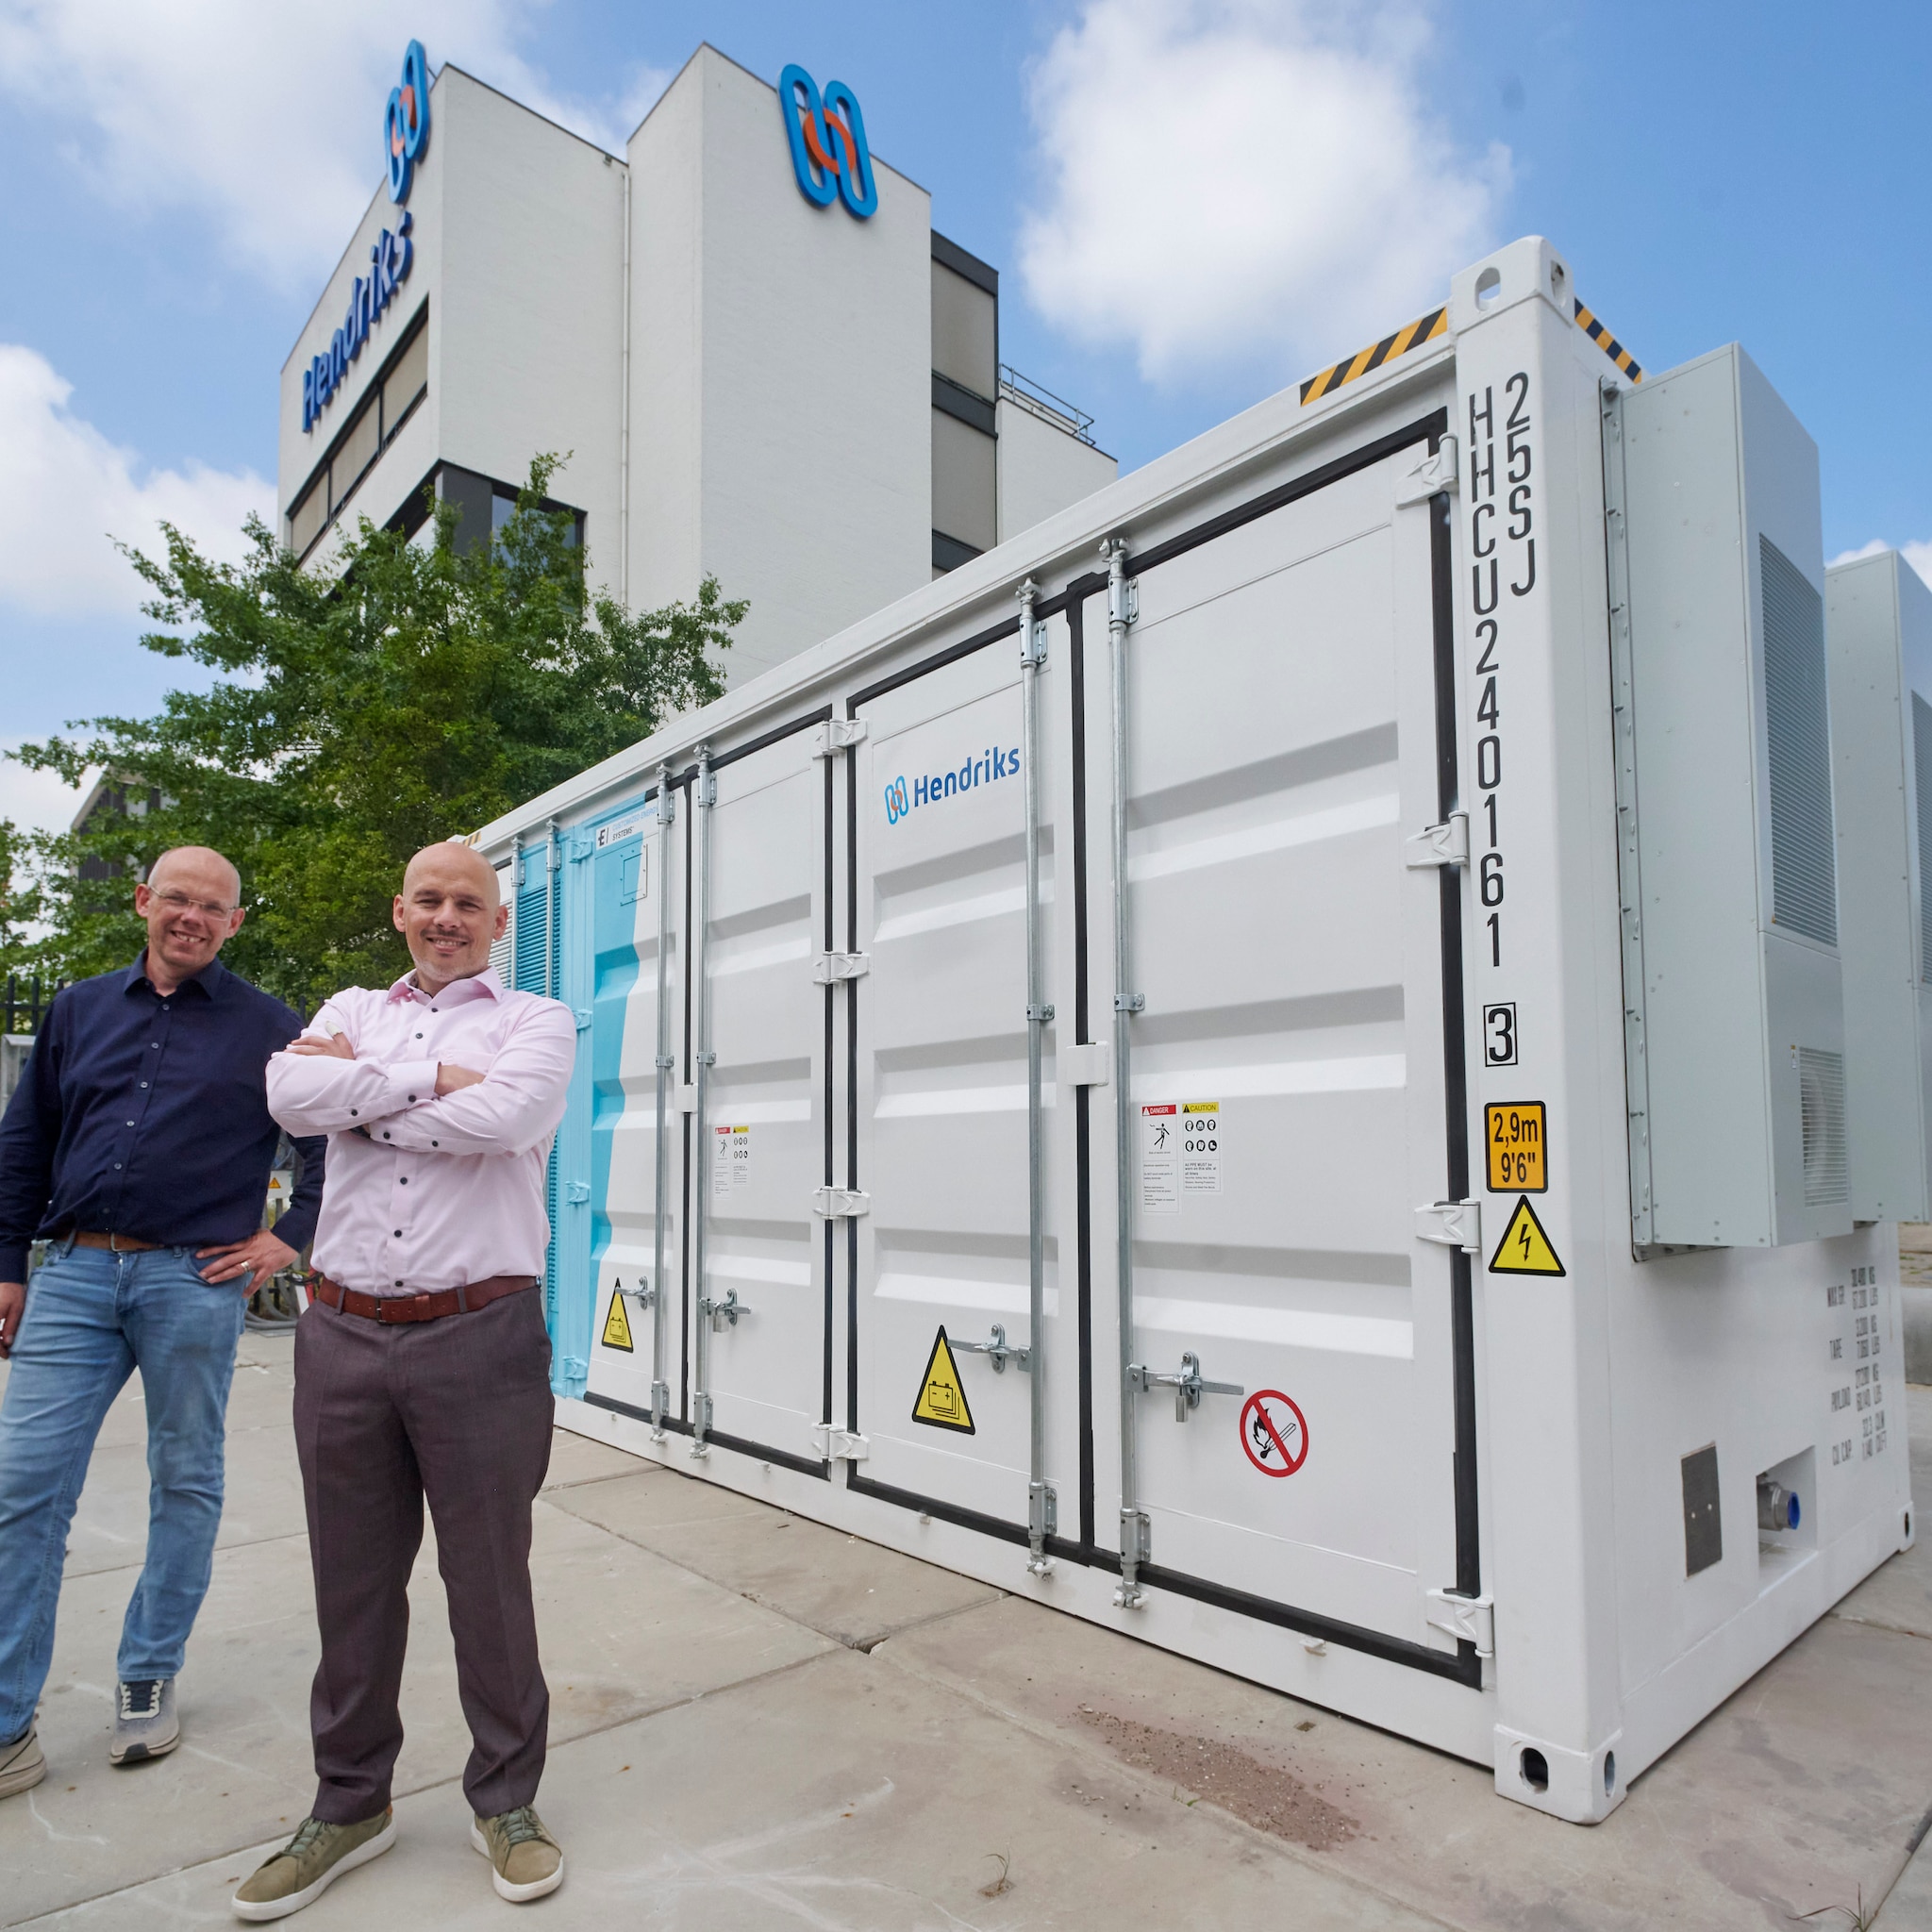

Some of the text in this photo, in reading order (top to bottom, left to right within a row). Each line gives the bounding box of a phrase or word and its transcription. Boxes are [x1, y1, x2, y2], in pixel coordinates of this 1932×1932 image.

[302, 210, 412, 433] Hendriks
[1505, 372, 1536, 596] 25SJ
[914, 746, 1020, 808] Hendriks
[1488, 1008, 1513, 1062] 3
[1190, 1104, 1216, 1112] CAUTION
[1493, 1111, 1539, 1148] 2,9m
